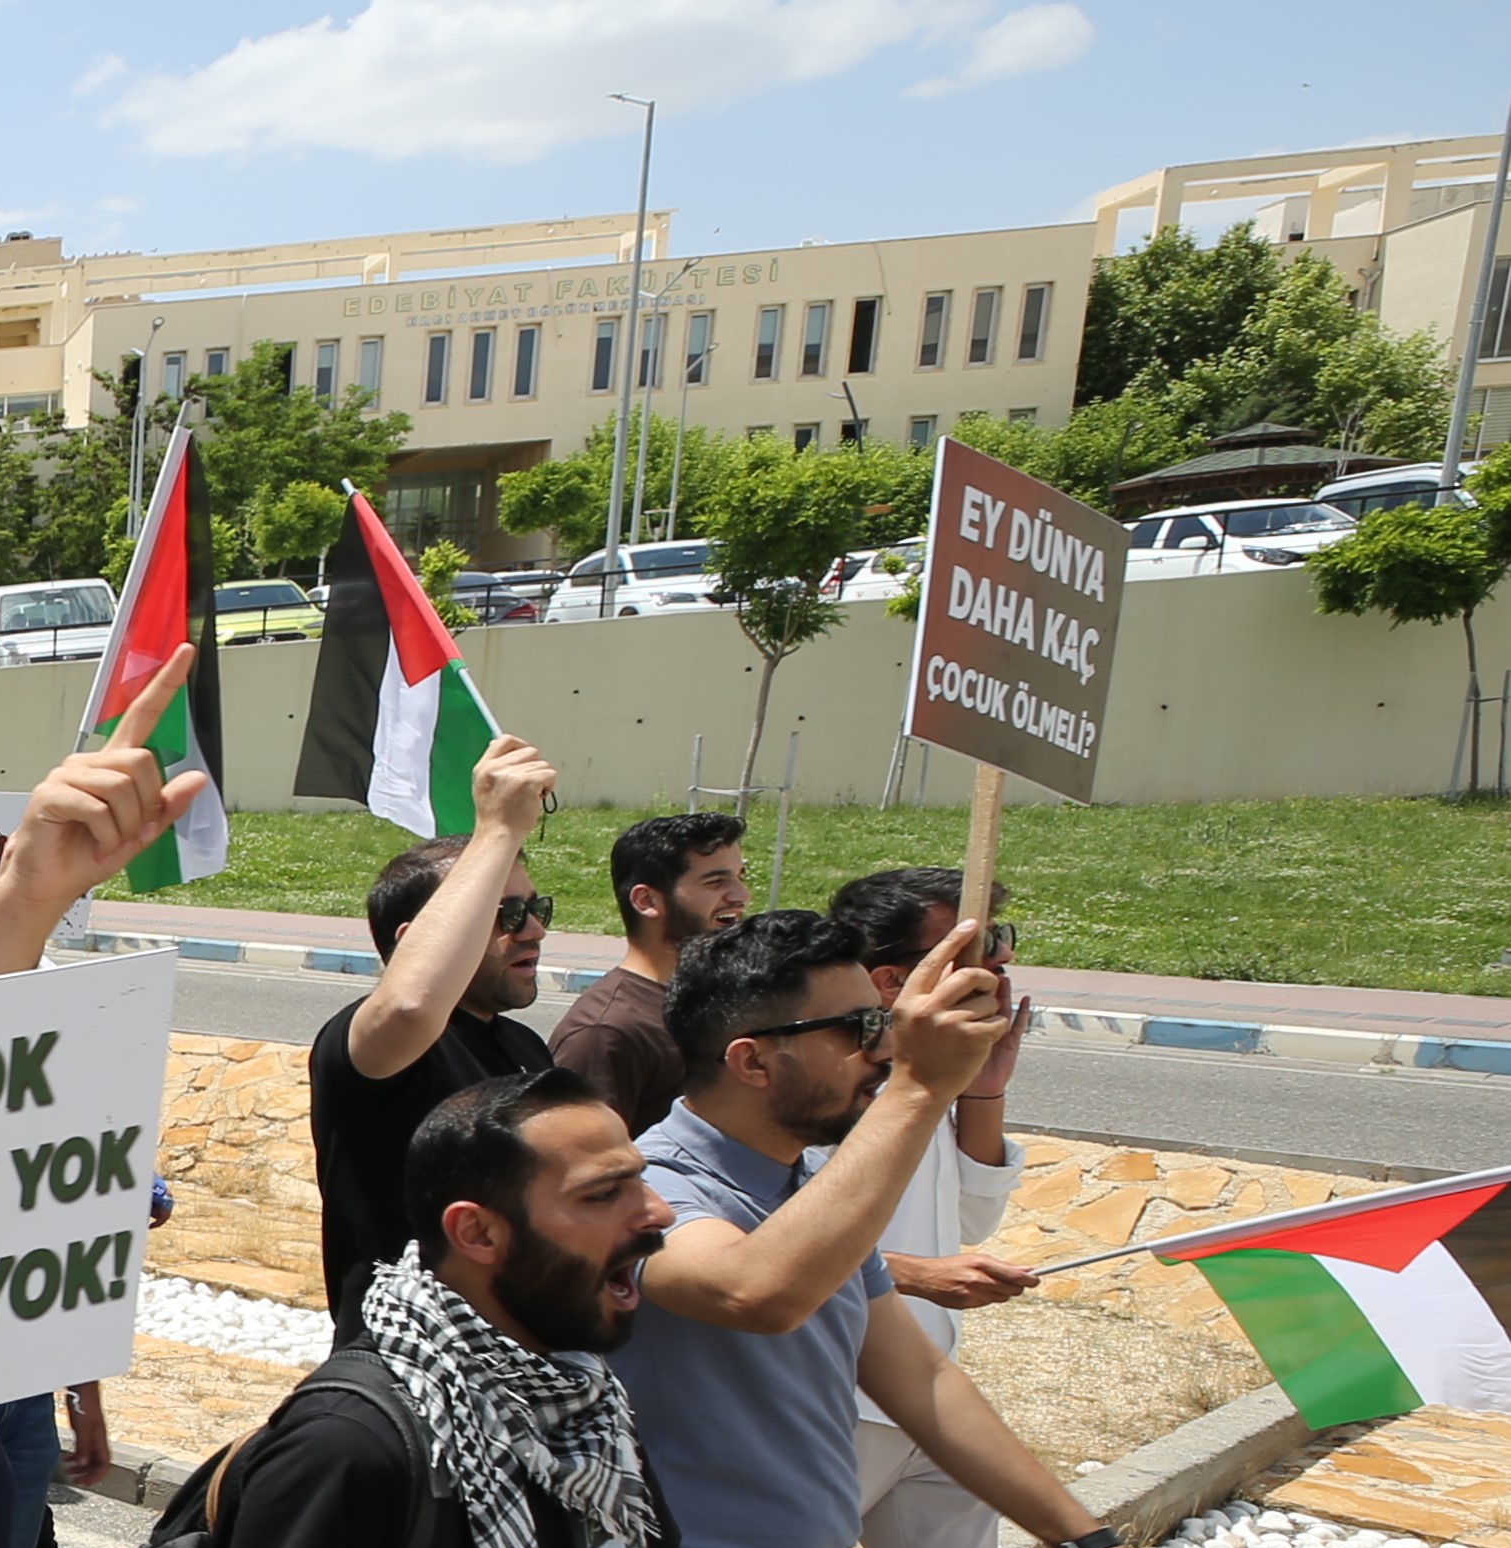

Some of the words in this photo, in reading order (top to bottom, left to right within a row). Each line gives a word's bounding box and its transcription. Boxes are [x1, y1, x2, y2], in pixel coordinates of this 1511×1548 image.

[344, 282, 533, 317] EDEBİYAT
[556, 258, 780, 299] FAKÜLTESİ
[960, 485, 1006, 550] EY
[1008, 508, 1105, 602] DÜNYA
[948, 566, 1035, 651] DAHA
[1041, 608, 1100, 686] KAÇ
[926, 655, 1010, 722] ÇOCUK
[1012, 681, 1096, 760] ÖLMELİ?
[10, 1126, 141, 1212] YOK
